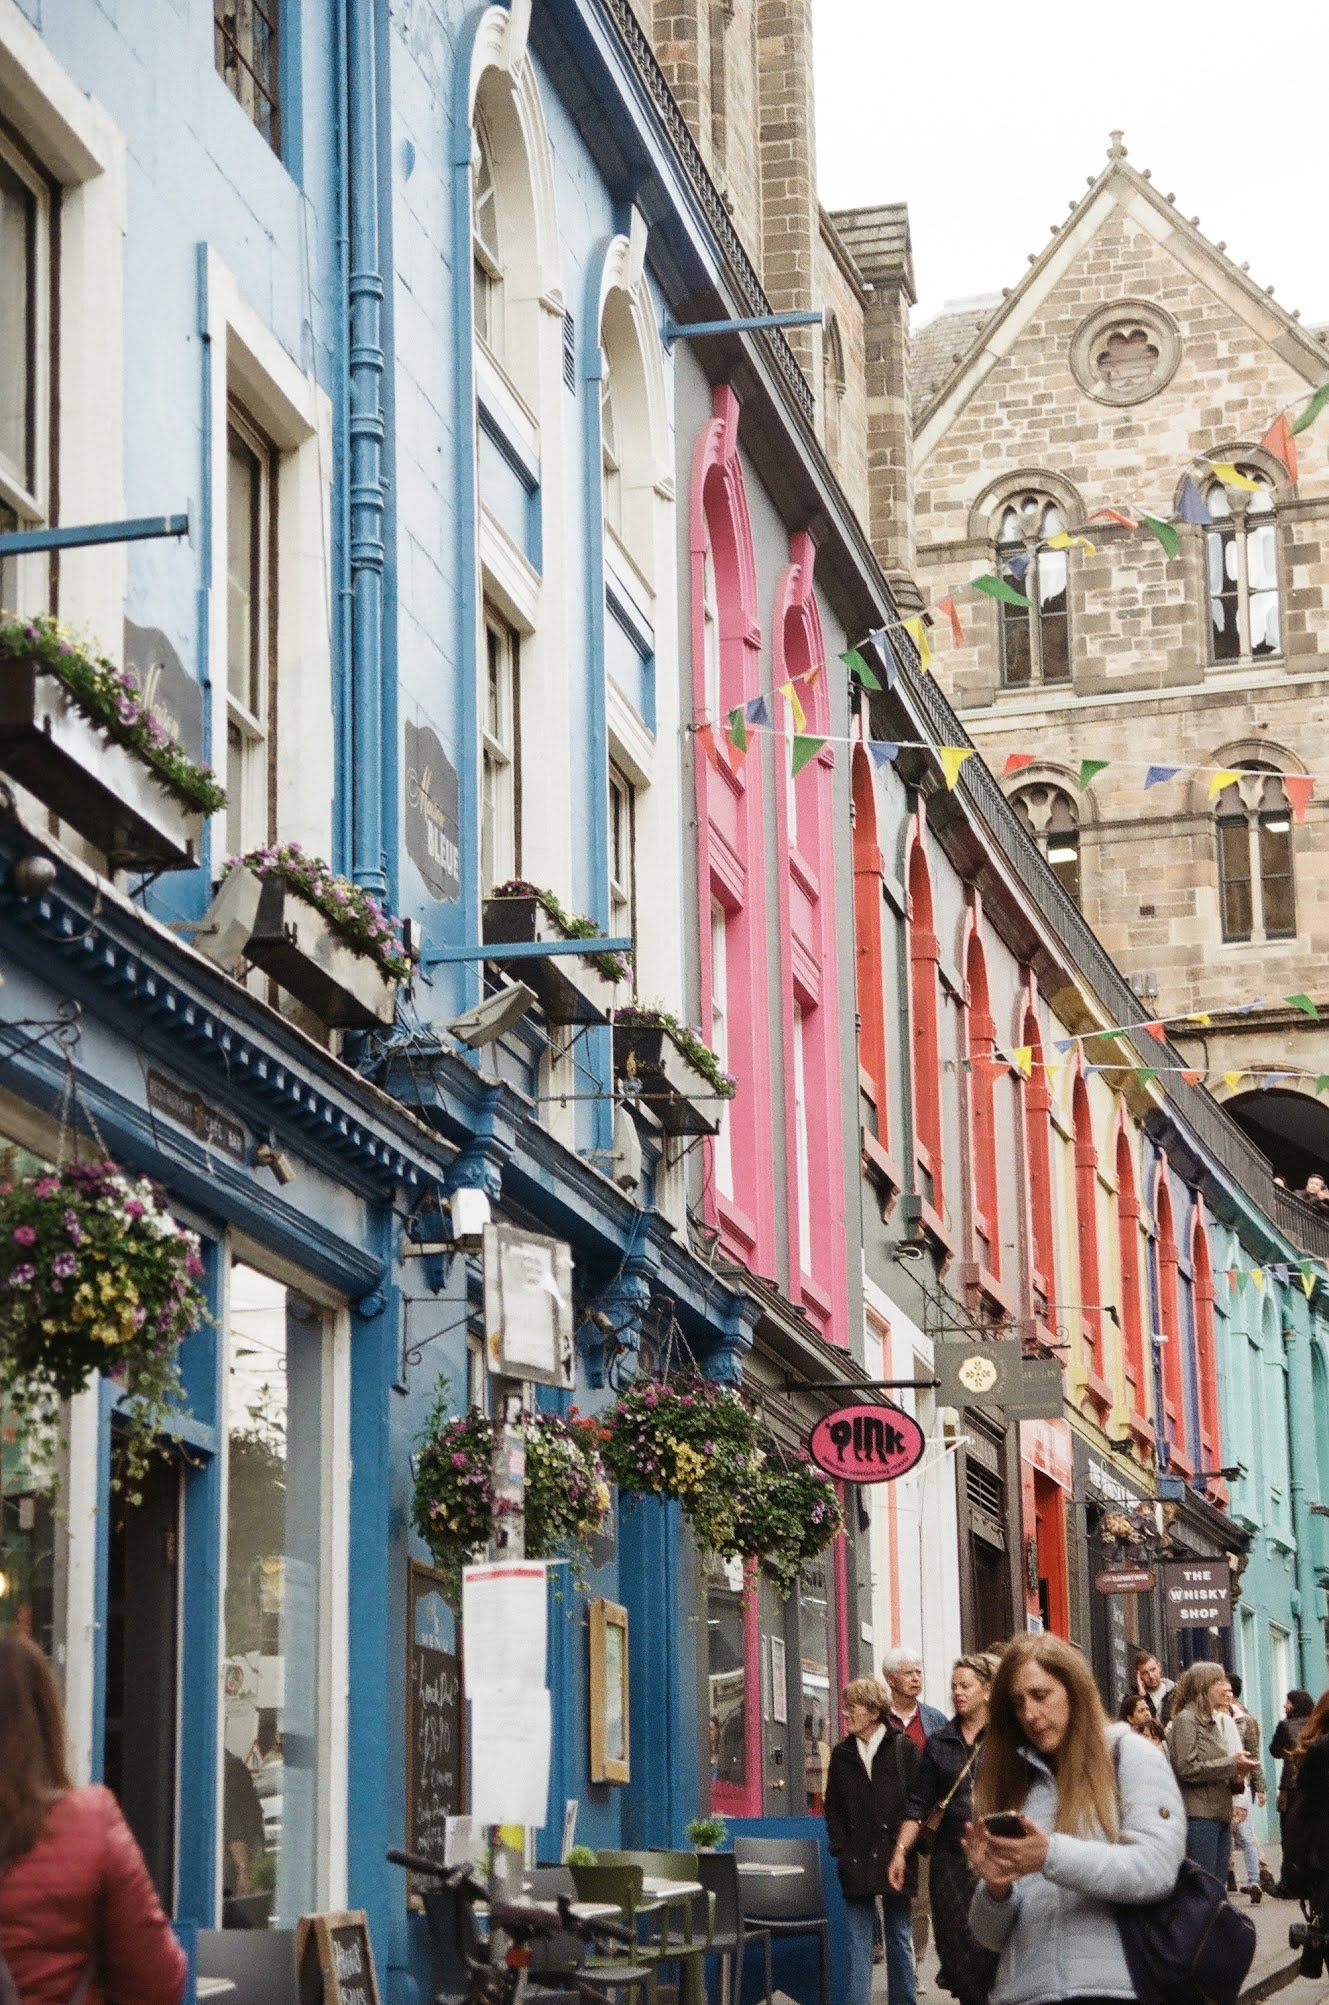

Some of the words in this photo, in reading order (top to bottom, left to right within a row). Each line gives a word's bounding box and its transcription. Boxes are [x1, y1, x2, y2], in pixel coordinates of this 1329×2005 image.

[427, 818, 459, 883] BLEUE
[1183, 1571, 1211, 1581] THE
[1169, 1588, 1227, 1602] WHISKY
[1180, 1608, 1218, 1619] SHOP
